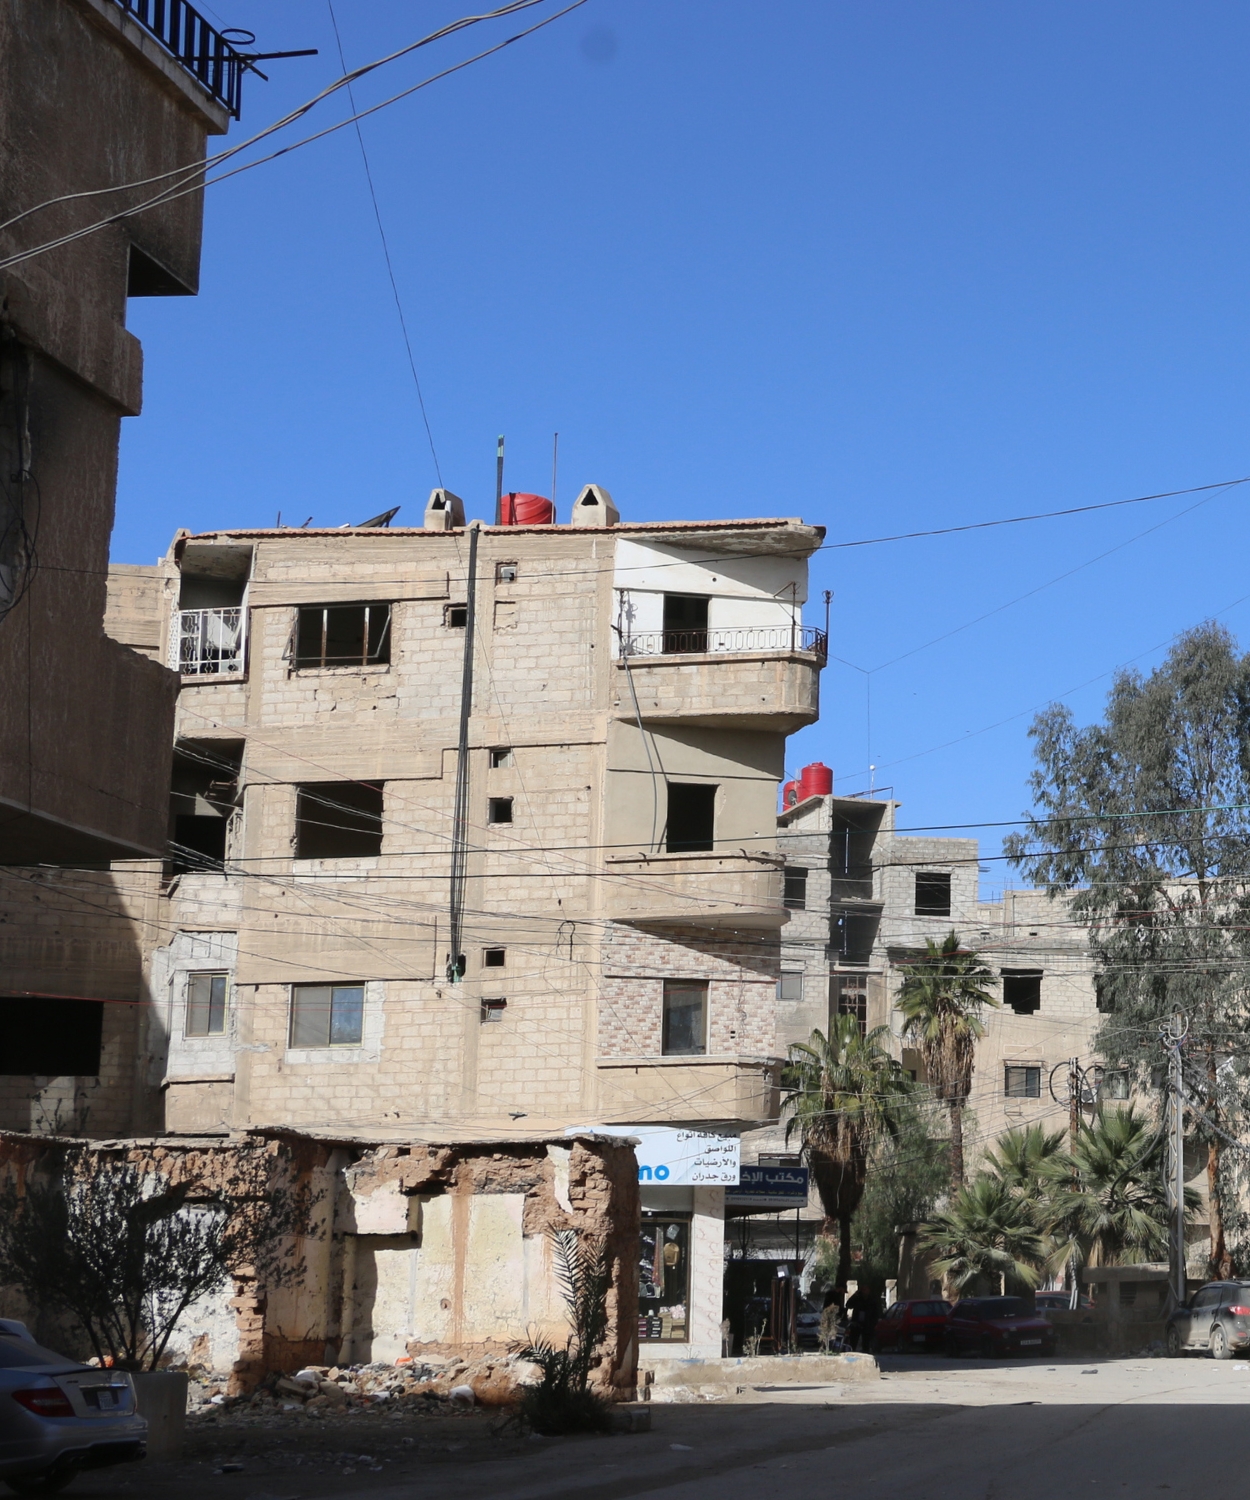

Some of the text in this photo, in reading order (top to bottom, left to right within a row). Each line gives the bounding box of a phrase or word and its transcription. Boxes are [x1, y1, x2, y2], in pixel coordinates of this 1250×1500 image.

[717, 1132, 737, 1142] مبيع
[692, 1172, 736, 1182] ورق جدران
[765, 1172, 804, 1185] مكتب
